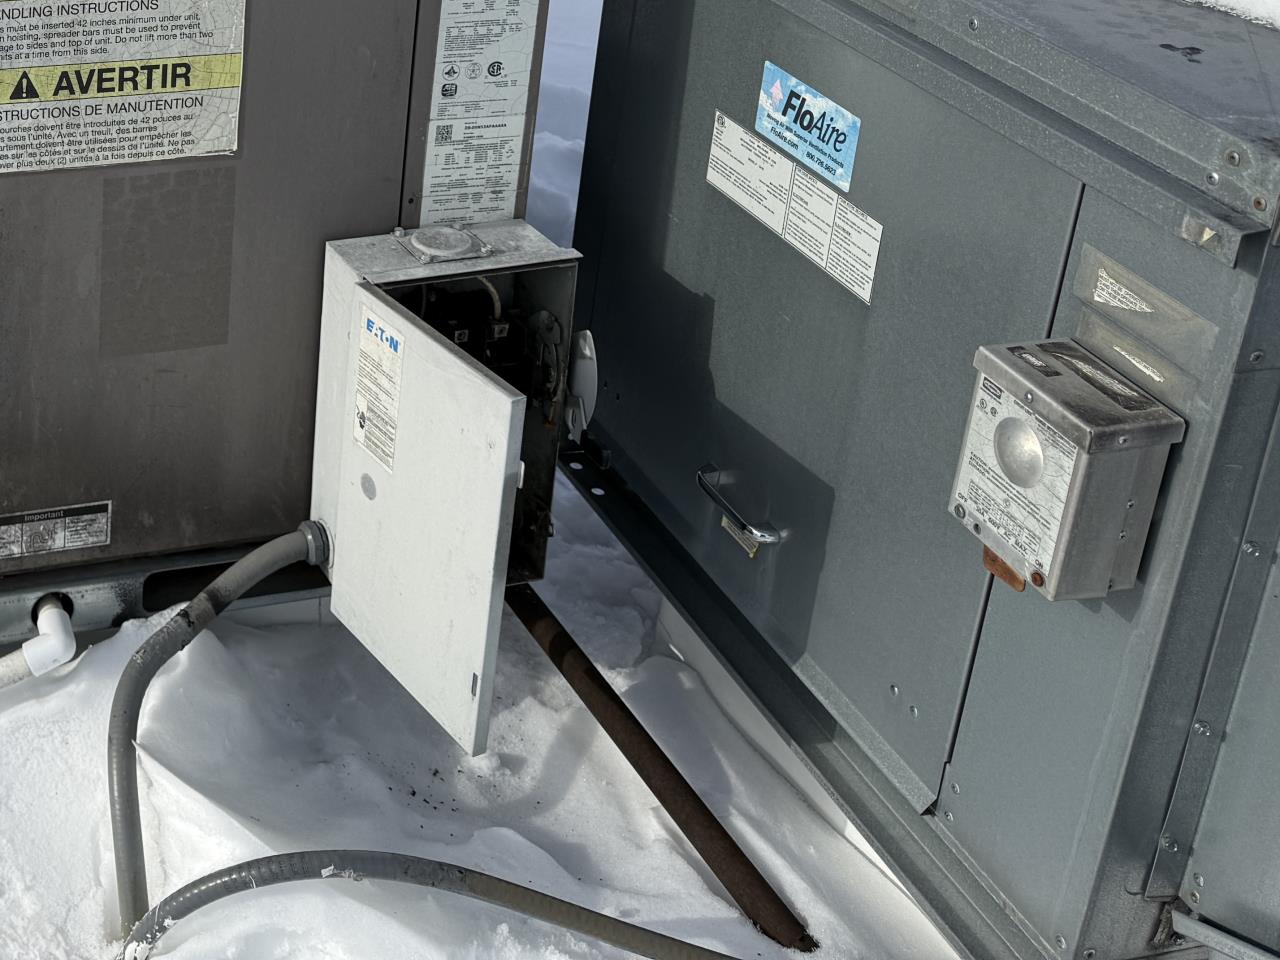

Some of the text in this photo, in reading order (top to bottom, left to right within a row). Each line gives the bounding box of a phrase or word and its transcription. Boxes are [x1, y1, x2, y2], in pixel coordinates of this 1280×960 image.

[56, 0, 159, 16] INSTRUCTIONS
[6, 23, 26, 33] must
[28, 22, 39, 31] be
[41, 20, 75, 30] inserted
[77, 19, 87, 28] 42
[89, 17, 117, 27] inches
[118, 15, 156, 25] minimum
[158, 13, 181, 22] under
[183, 12, 200, 21] unit.
[6, 31, 41, 43] hoisting,
[42, 29, 80, 41] spreader
[82, 27, 100, 37] bars
[102, 26, 123, 35] must
[125, 25, 136, 34] be
[138, 23, 158, 33] used
[159, 23, 168, 31] to
[170, 21, 200, 32] prevent
[16, 42, 24, 51] to
[25, 40, 47, 50] sides
[50, 39, 65, 48] and
[68, 38, 81, 48] top
[84, 37, 92, 46] of
[94, 35, 111, 45] unit.
[115, 35, 127, 44] Do
[129, 34, 142, 43] not
[144, 33, 154, 42] lift
[156, 33, 177, 41] more
[178, 30, 197, 40] than
[199, 29, 213, 38] two
[14, 52, 22, 60] at
[32, 50, 49, 59] time
[51, 48, 71, 57] from
[72, 46, 88, 56] this
[90, 45, 109, 55] side.
[52, 62, 192, 96] AVERTIR
[84, 103, 102, 116] DE
[106, 95, 203, 115] MANUTENTION
[33, 121, 63, 132] doivent
[65, 119, 81, 130] être
[83, 116, 125, 129] introduites
[127, 117, 138, 125] de
[139, 116, 150, 124] 42
[152, 113, 181, 124] pouces
[781, 89, 847, 153] FloAire
[6, 134, 26, 143] sous
[56, 129, 77, 139] Avec
[78, 129, 89, 137] un
[91, 127, 113, 137] treuil,
[115, 126, 130, 135] des
[132, 123, 157, 133] barres
[35, 139, 64, 149] doivent
[66, 137, 82, 147] être
[84, 135, 116, 146] utilisées
[118, 134, 137, 144] pour
[139, 129, 178, 142] empêcher
[180, 129, 192, 137] les
[770, 126, 799, 150] FloAire.com
[11, 151, 24, 159] sur
[25, 149, 37, 158] les
[39, 147, 61, 157] côtés
[88, 145, 95, 153] le
[97, 143, 125, 153] dessus
[127, 142, 137, 150] de
[167, 138, 179, 147] Ne
[180, 138, 194, 147] pas
[16, 159, 33, 169] plus
[34, 156, 54, 166] deux
[94, 153, 100, 161] à
[101, 152, 109, 161] la
[111, 151, 125, 160] fois
[127, 148, 153, 160] depuis
[809, 140, 827, 158] Ventilation
[828, 152, 845, 169] Products
[366, 317, 399, 353] EATON
[956, 492, 968, 503] OFF
[24, 511, 64, 521] Important
[1034, 558, 1044, 569] ON
